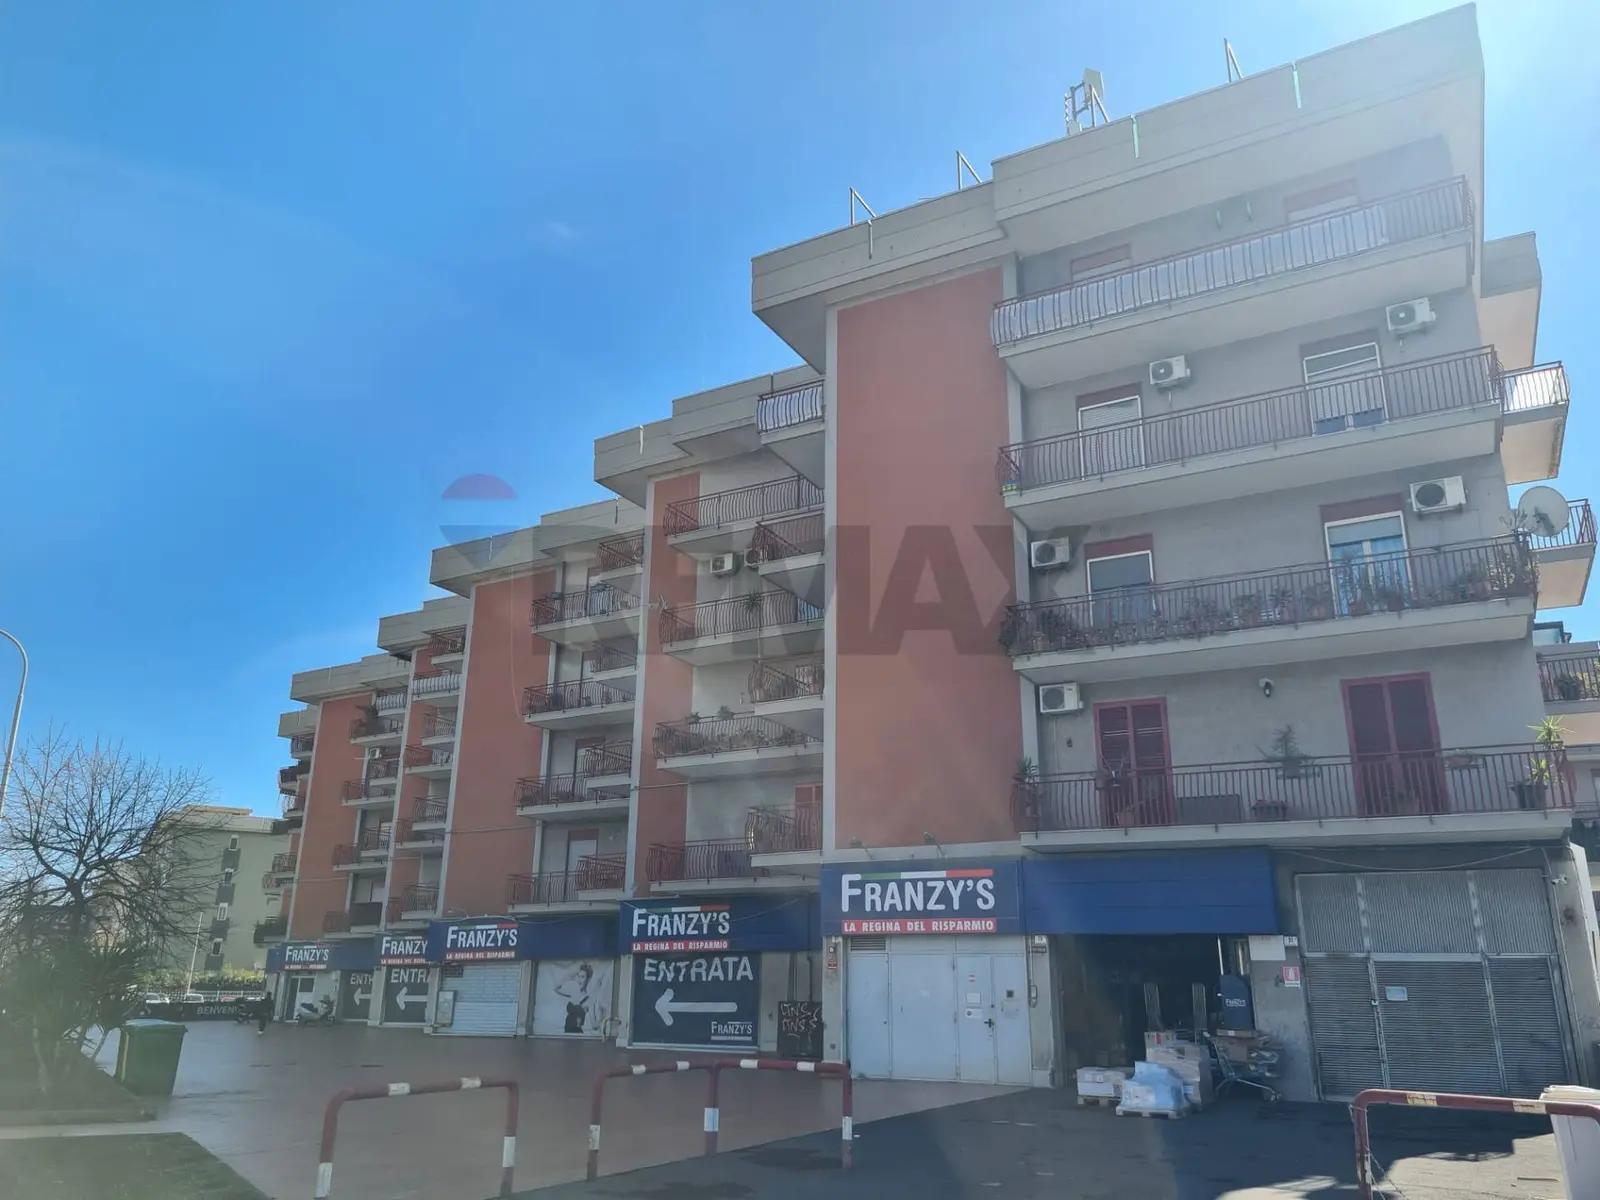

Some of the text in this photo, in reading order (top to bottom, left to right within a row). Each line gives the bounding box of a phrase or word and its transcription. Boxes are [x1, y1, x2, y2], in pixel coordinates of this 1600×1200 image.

[841, 873, 995, 912] FRANZY'S
[632, 908, 730, 937] FRANZY'S
[844, 920, 994, 932] LA REGINA DEL RISPARMIO
[381, 936, 428, 955] FRANZY
[446, 926, 518, 949] FRANZY'S
[633, 941, 728, 951] LA REGINA DEL RISPARMIO
[285, 945, 330, 962] FRANZY'S
[390, 968, 430, 983] ENTR
[643, 956, 754, 983] ENTRATA
[196, 1005, 238, 1015] BENVEN
[711, 1021, 753, 1034] FRANZY'S
